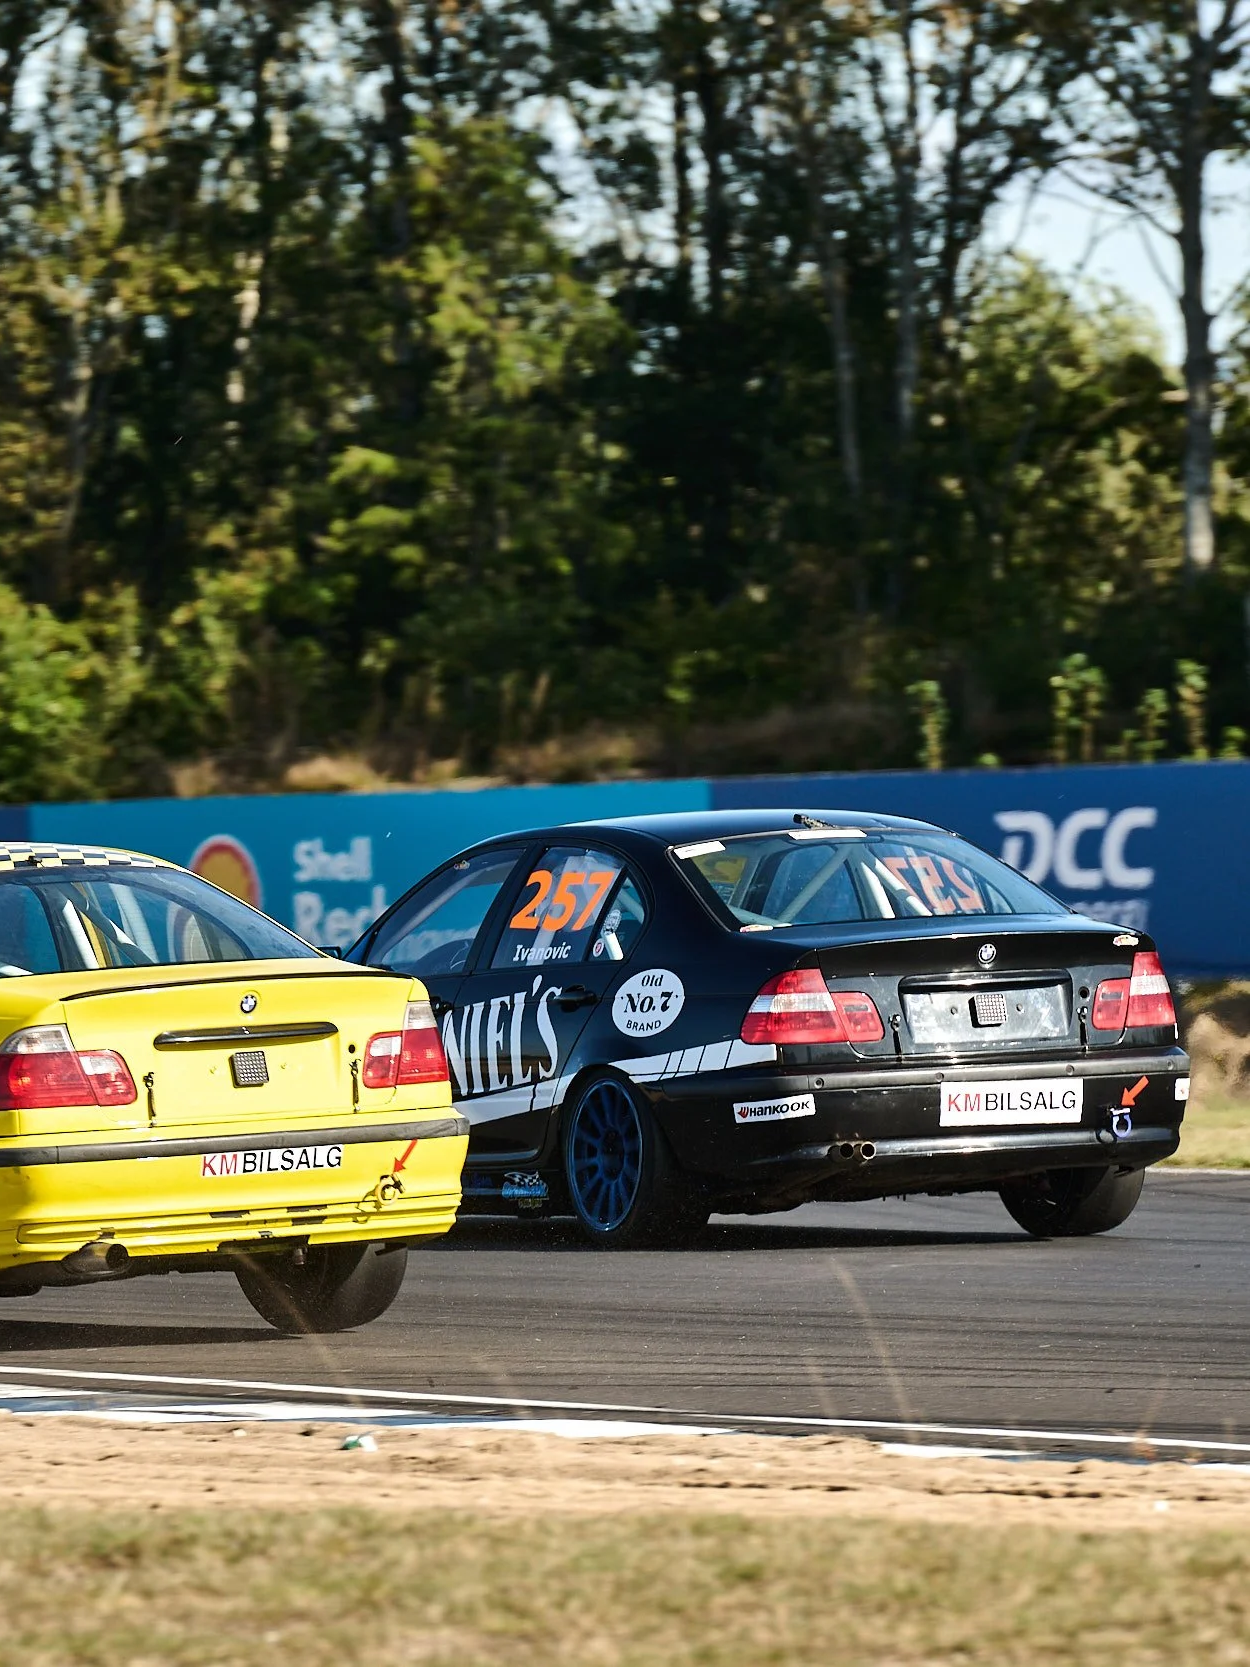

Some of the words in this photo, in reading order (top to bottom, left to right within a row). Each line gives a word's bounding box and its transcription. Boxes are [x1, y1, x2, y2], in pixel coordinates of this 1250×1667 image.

[293, 836, 373, 882] Shell
[993, 806, 1157, 890] DCC
[510, 870, 614, 932] 257
[513, 942, 571, 962] Ivanovic
[641, 975, 664, 987] Old
[626, 1019, 662, 1032] BRAND
